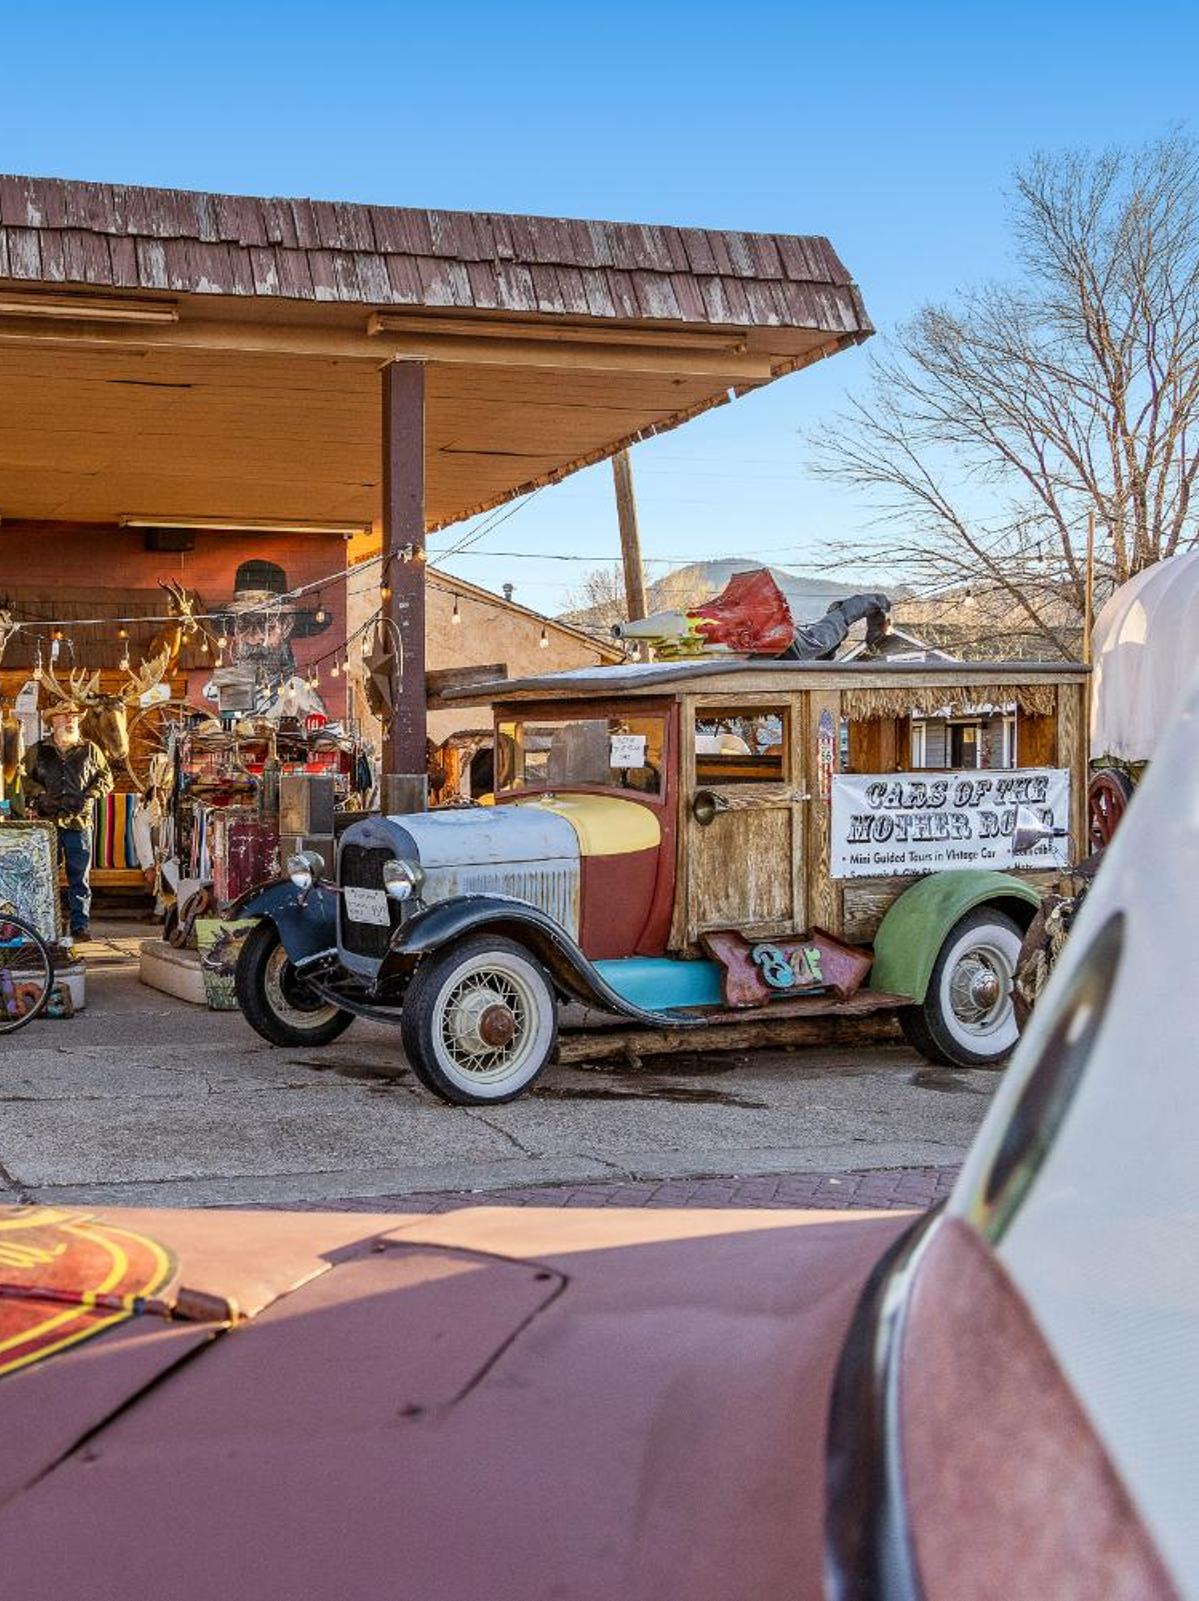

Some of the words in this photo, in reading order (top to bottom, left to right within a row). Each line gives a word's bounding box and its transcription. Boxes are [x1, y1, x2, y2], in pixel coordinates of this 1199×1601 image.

[866, 780, 950, 809] CARS
[953, 779, 993, 808] OF
[994, 775, 1050, 806] THE
[847, 810, 973, 843] MOTHER
[977, 808, 1055, 838] ROD
[850, 853, 870, 864] Mini
[873, 851, 905, 864] Guided
[909, 850, 932, 862] Tours
[935, 852, 943, 861] in
[946, 849, 979, 863] Vintage
[981, 847, 996, 859] Car
